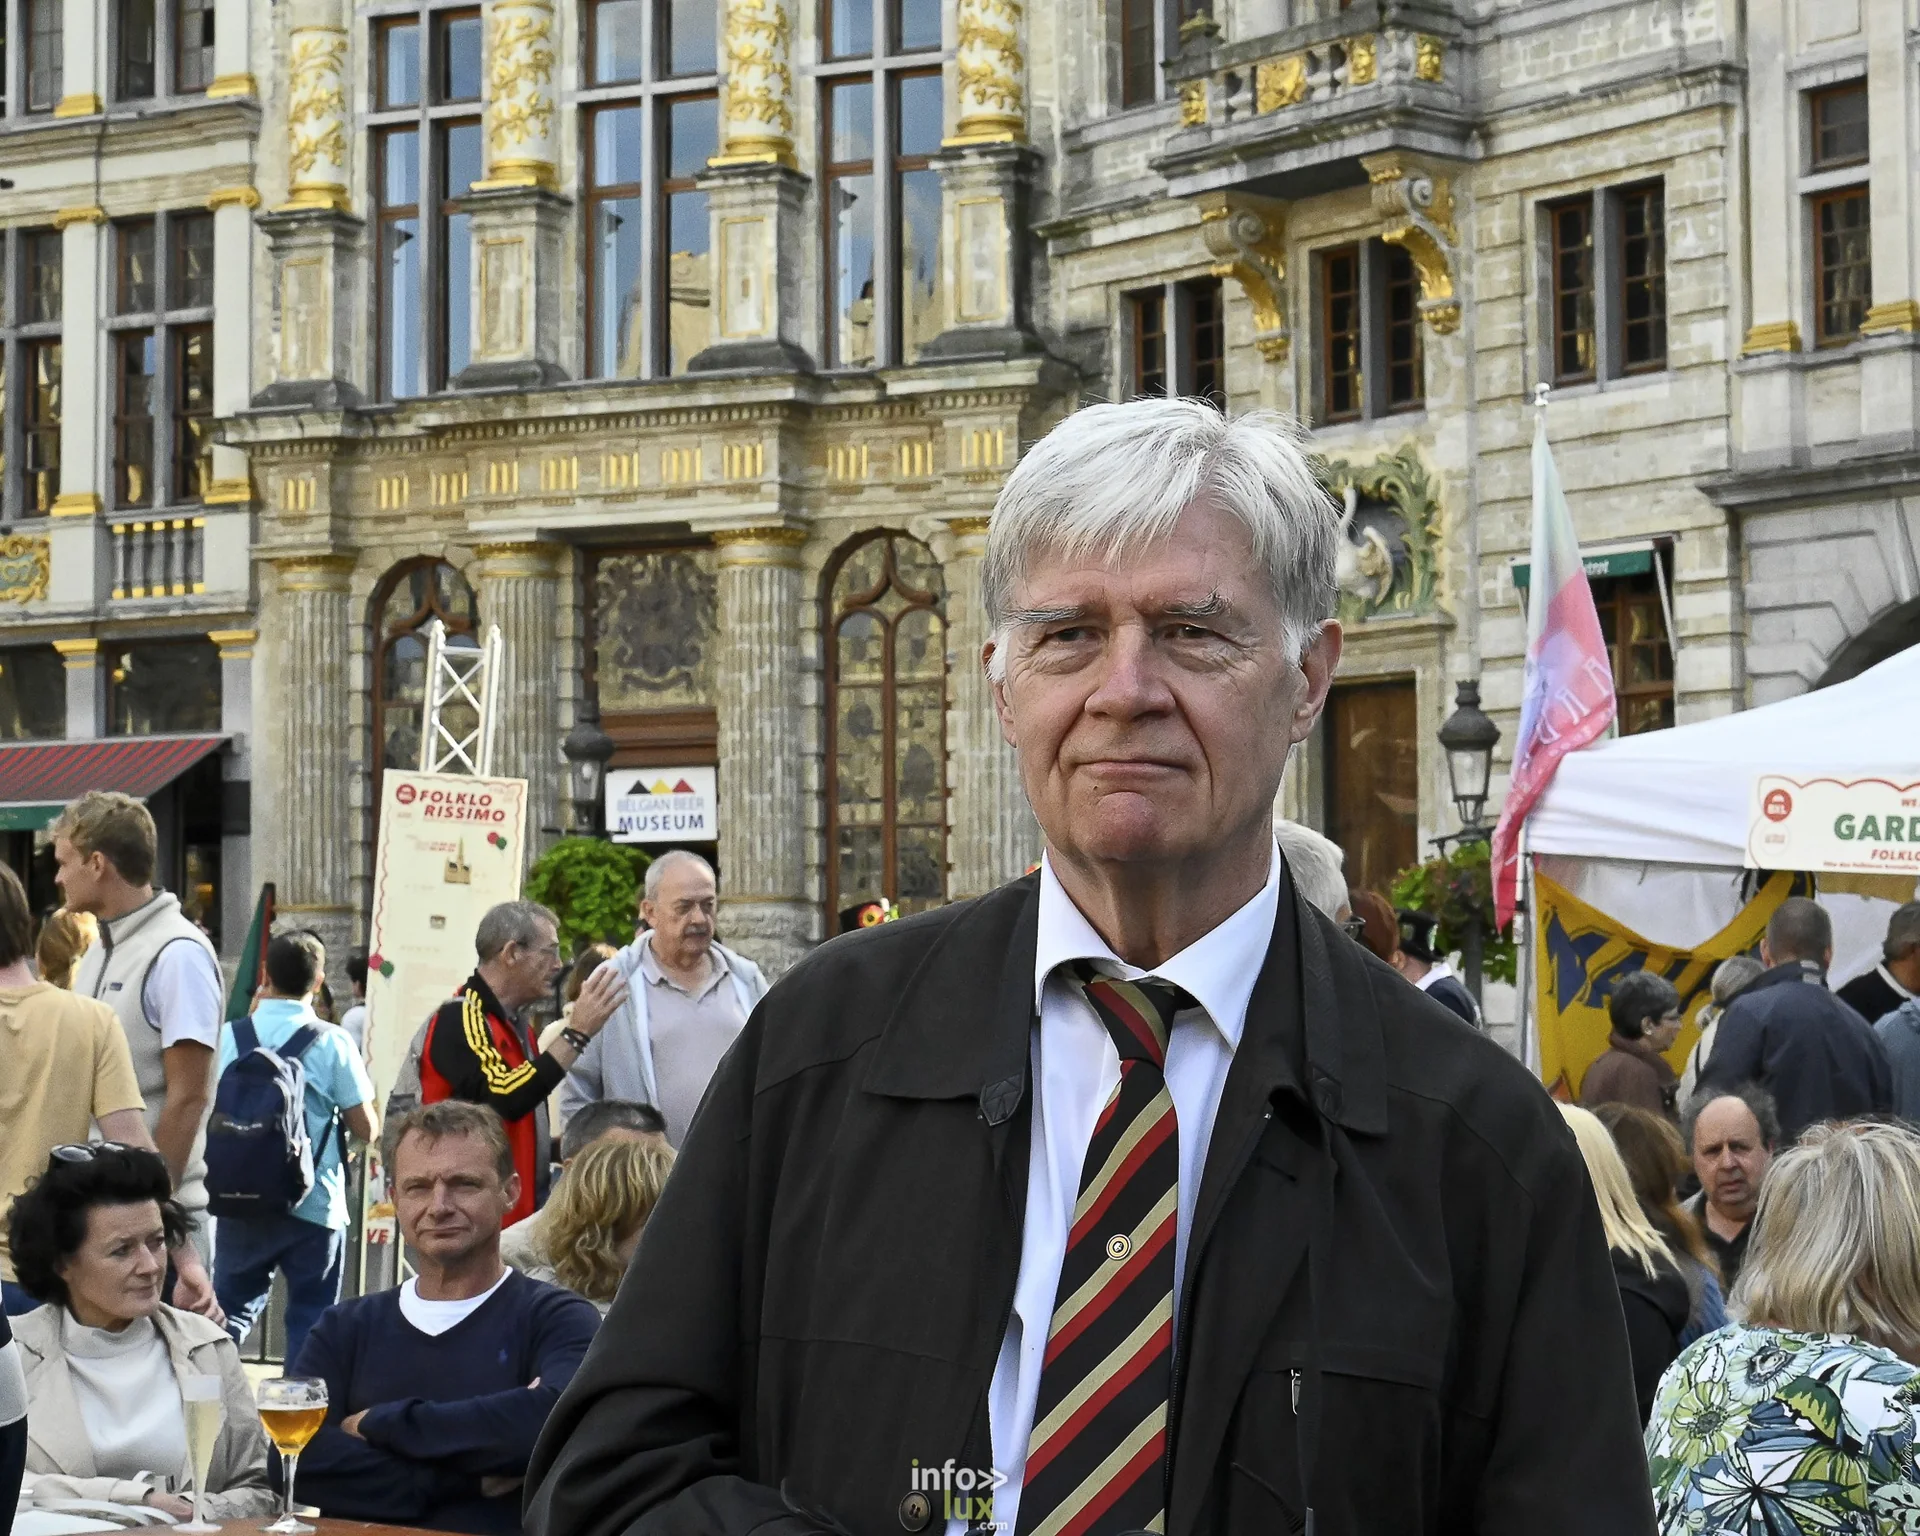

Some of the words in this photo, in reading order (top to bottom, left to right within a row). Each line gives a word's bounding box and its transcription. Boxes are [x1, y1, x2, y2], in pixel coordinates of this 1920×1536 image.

[419, 790, 493, 807] FOLKLO
[617, 798, 671, 812] BELGIAN
[673, 796, 705, 811] BEER
[424, 804, 506, 822] RISSIMO
[618, 814, 705, 831] MUSEUM
